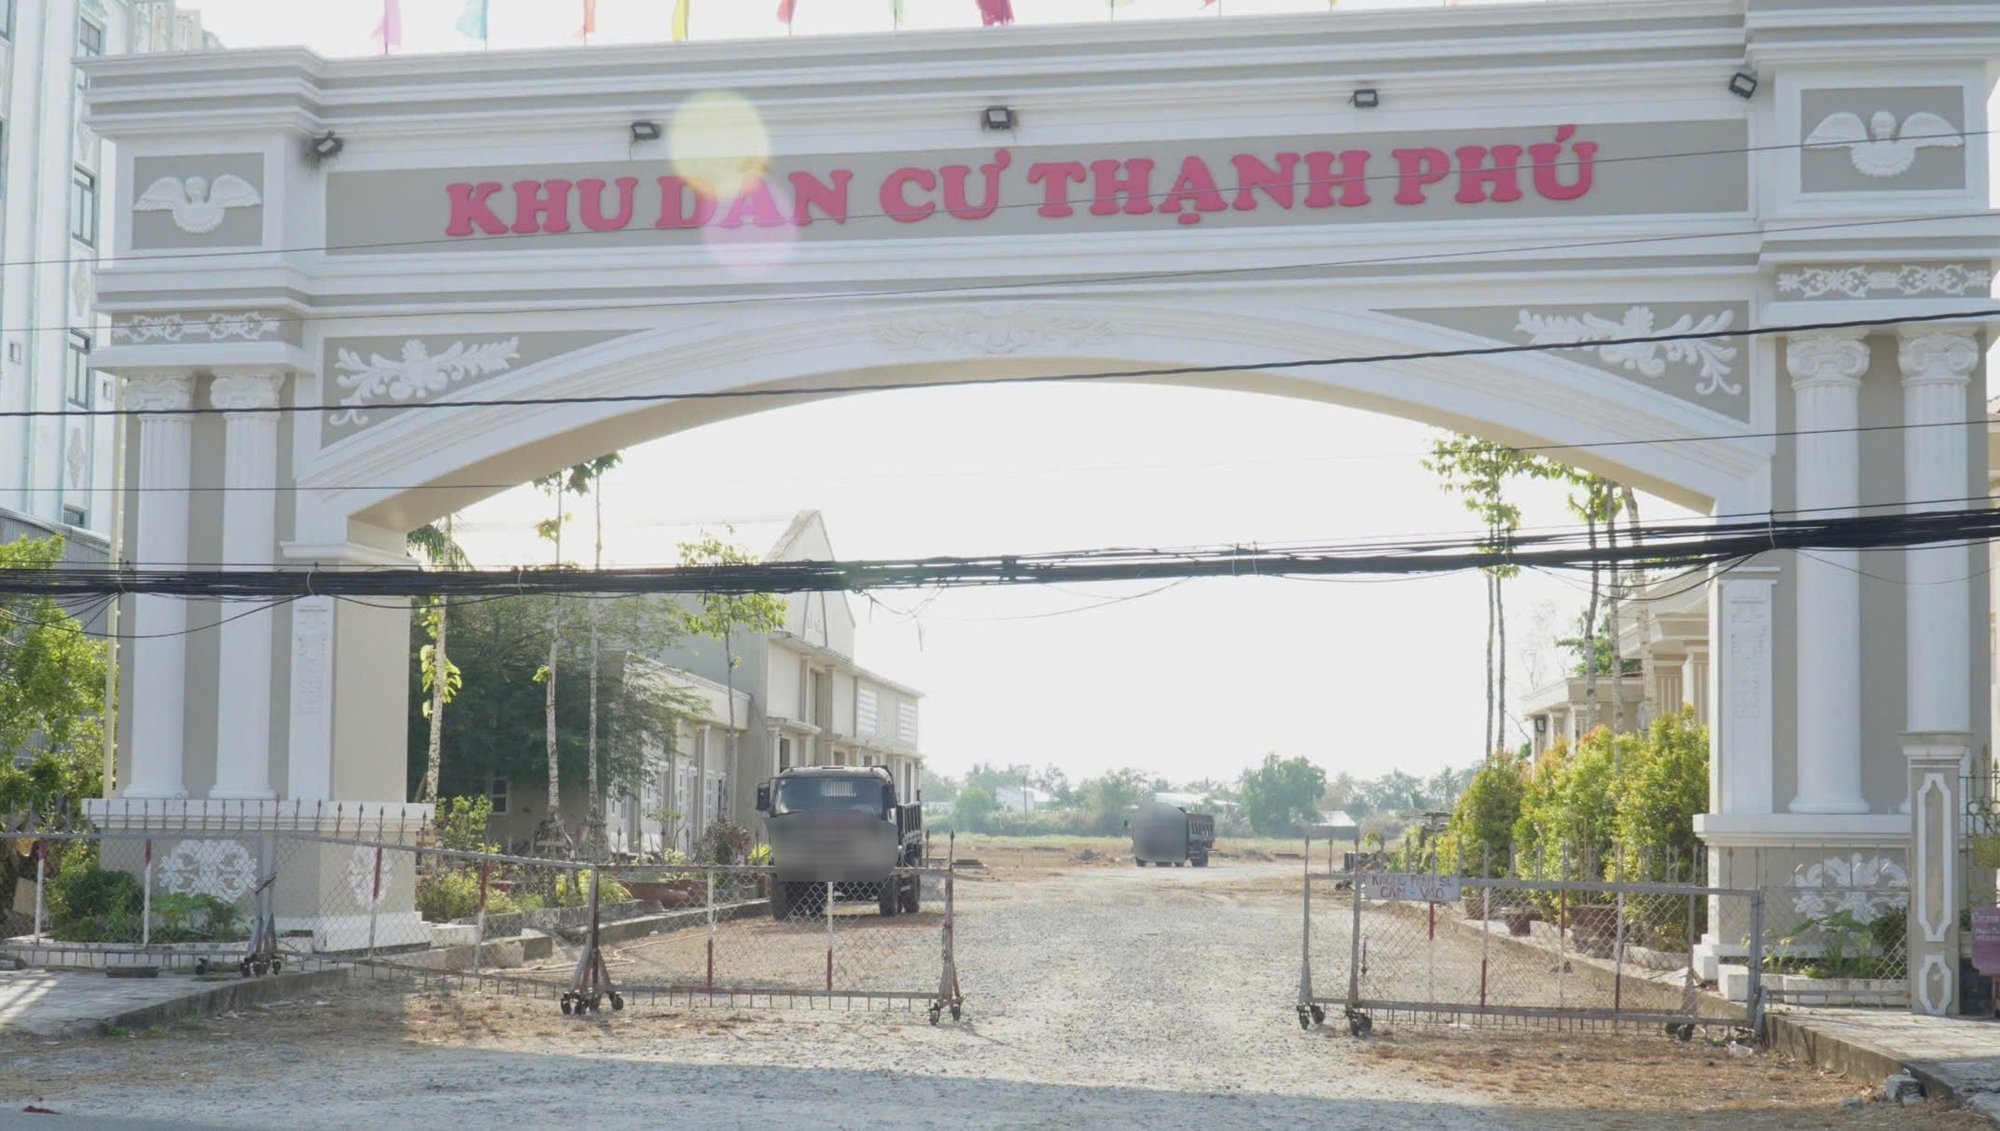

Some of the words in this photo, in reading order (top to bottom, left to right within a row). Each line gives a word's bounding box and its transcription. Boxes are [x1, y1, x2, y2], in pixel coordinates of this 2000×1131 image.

[445, 175, 638, 236] KHU
[655, 157, 853, 229] DÂN
[878, 148, 1011, 223] CƯ
[1027, 149, 1371, 225] THẠNH
[1391, 123, 1598, 205] PHÚ
